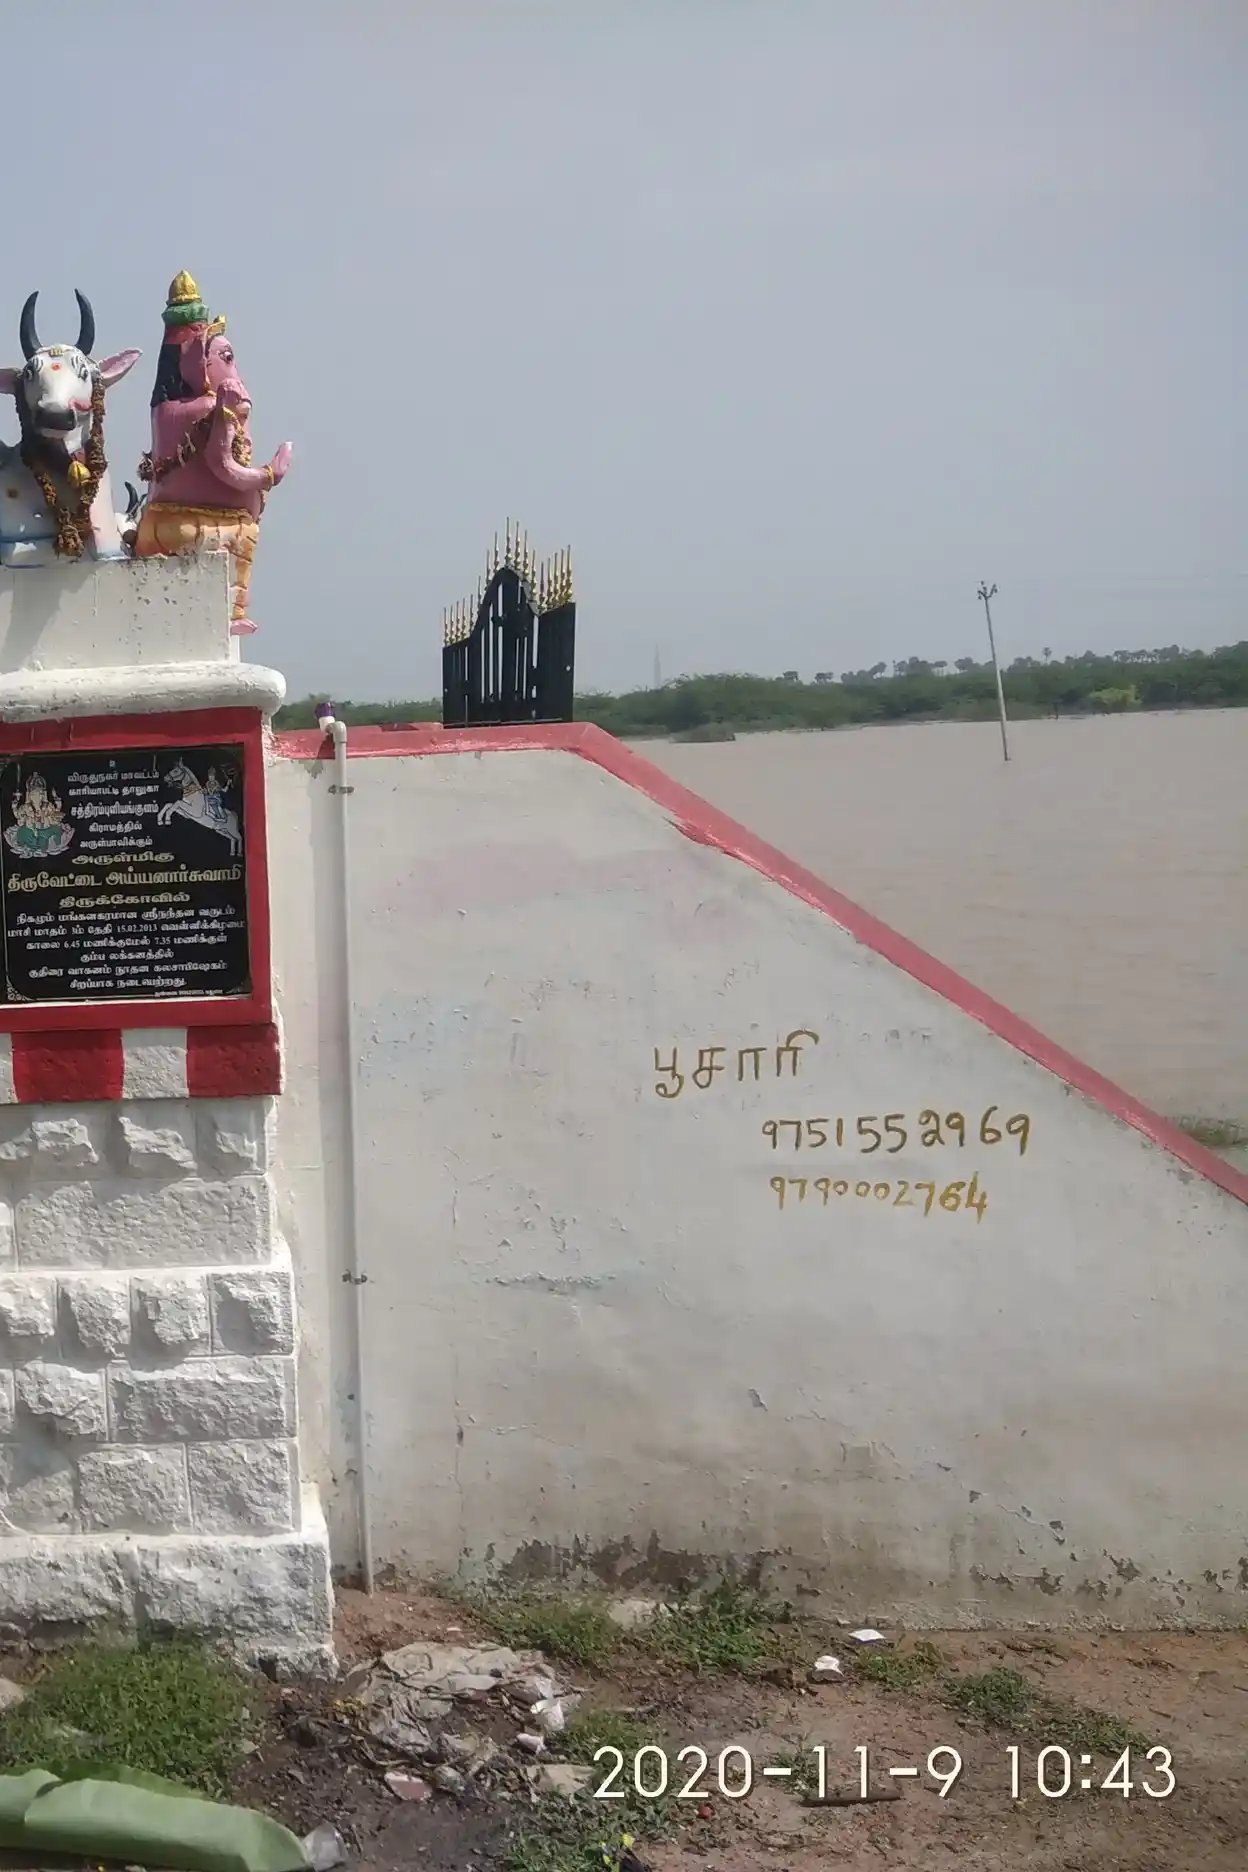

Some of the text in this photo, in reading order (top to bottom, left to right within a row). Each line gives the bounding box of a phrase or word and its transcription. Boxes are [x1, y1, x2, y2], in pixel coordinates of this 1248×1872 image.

[68, 769, 160, 784] விருதுநகர் மாவட்டம்
[68, 785, 160, 796] காரியாபட்டி தாலுகா
[88, 820, 143, 834] கிராமத்தில்
[71, 850, 176, 866] அருள்மிகு
[7, 871, 102, 893] திருவேட்டை
[58, 891, 190, 908] திருக்கோவில்
[16, 912, 55, 925] நிகழும்
[198, 904, 236, 918] வருடம்
[7, 926, 31, 938] மாசி
[34, 924, 68, 937] மாதம்
[88, 924, 113, 936] தேதி
[26, 941, 60, 950] காலை
[64, 940, 80, 948] 6.45
[80, 950, 106, 962] கும்ப
[28, 966, 64, 978] குதிரை
[68, 964, 112, 976] வாகனம்
[70, 978, 114, 990] சிறப்பாக
[654, 1028, 820, 1098] பூசாரி
[769, 1170, 988, 1224] 9790002764
